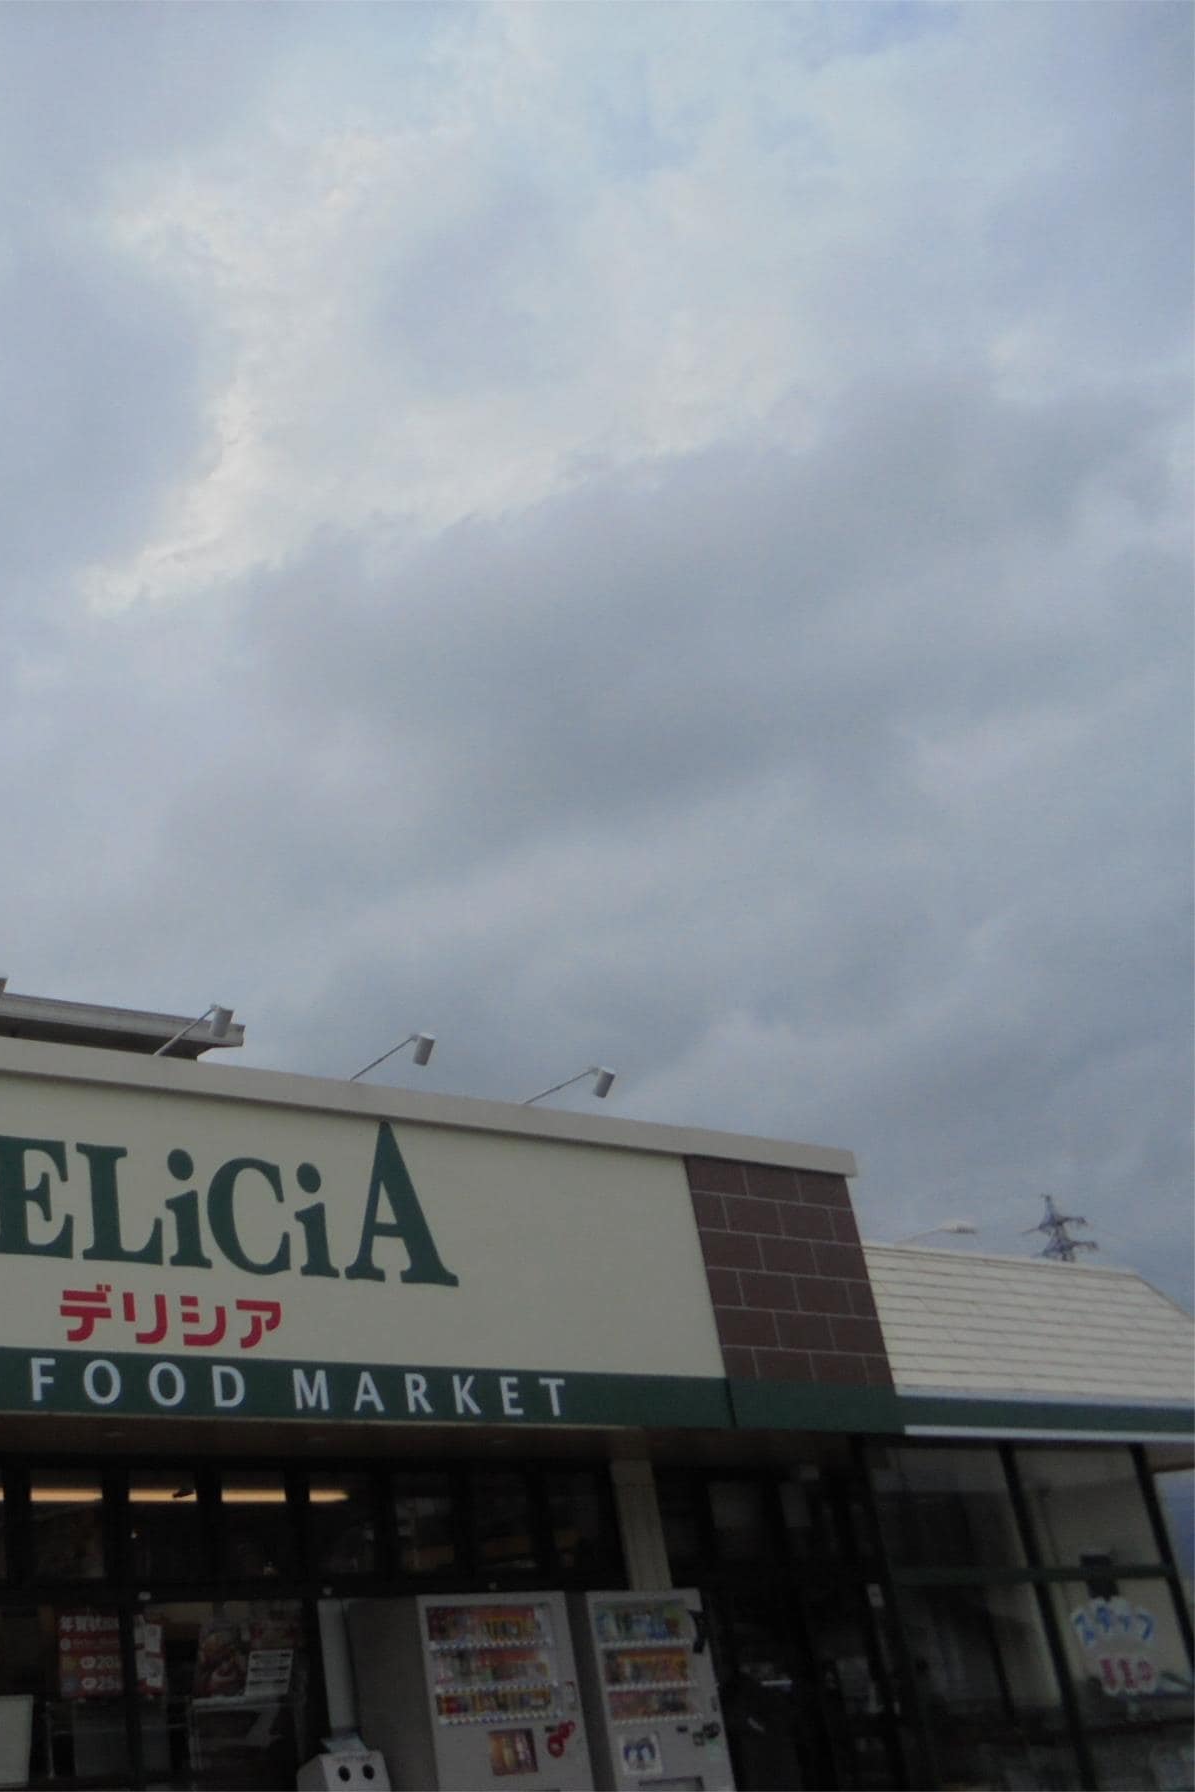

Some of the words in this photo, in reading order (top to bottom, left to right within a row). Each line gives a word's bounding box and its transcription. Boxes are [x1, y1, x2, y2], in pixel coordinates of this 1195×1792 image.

[60, 1285, 282, 1349] デリシア
[29, 1357, 246, 1409] FOOD
[291, 1368, 566, 1417] MARKET
